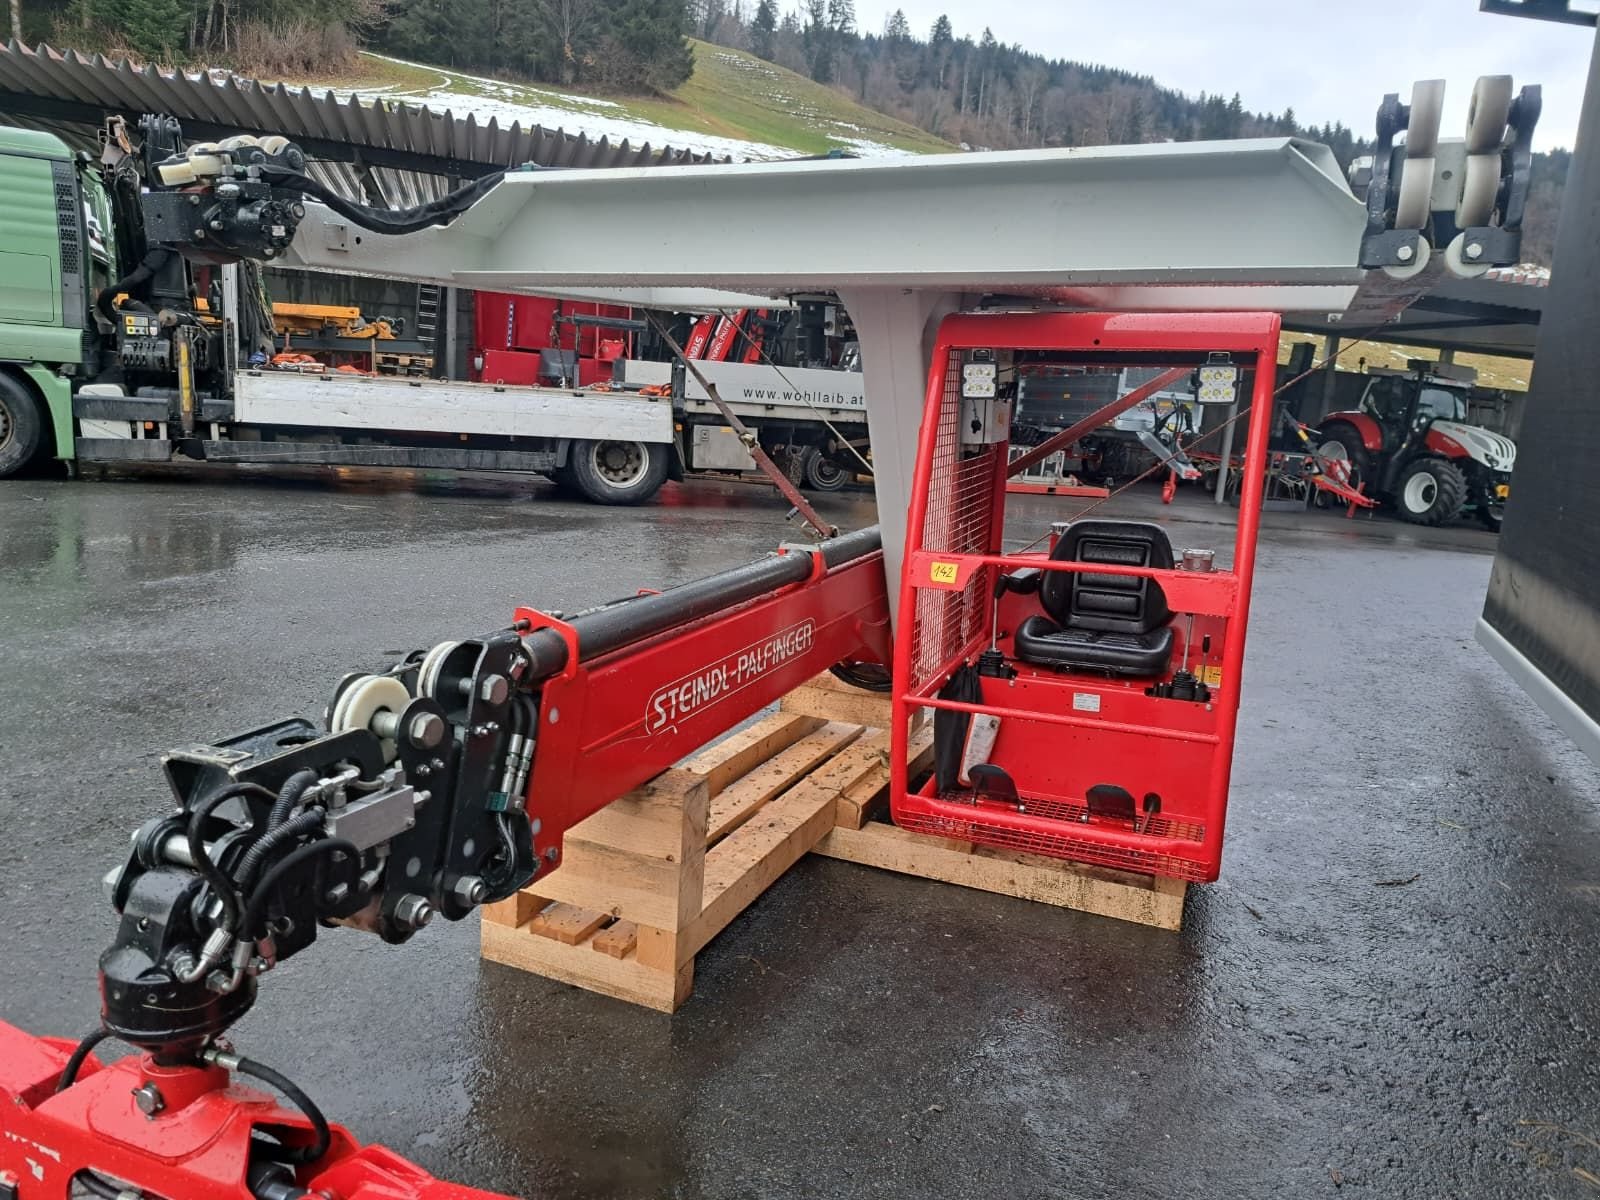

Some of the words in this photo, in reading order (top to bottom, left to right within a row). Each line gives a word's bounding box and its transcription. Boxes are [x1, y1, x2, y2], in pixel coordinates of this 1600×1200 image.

[743, 388, 864, 405] www.wohllaib.at
[934, 565, 954, 578] 142
[653, 623, 812, 729] STEINDL-PALFINGER
